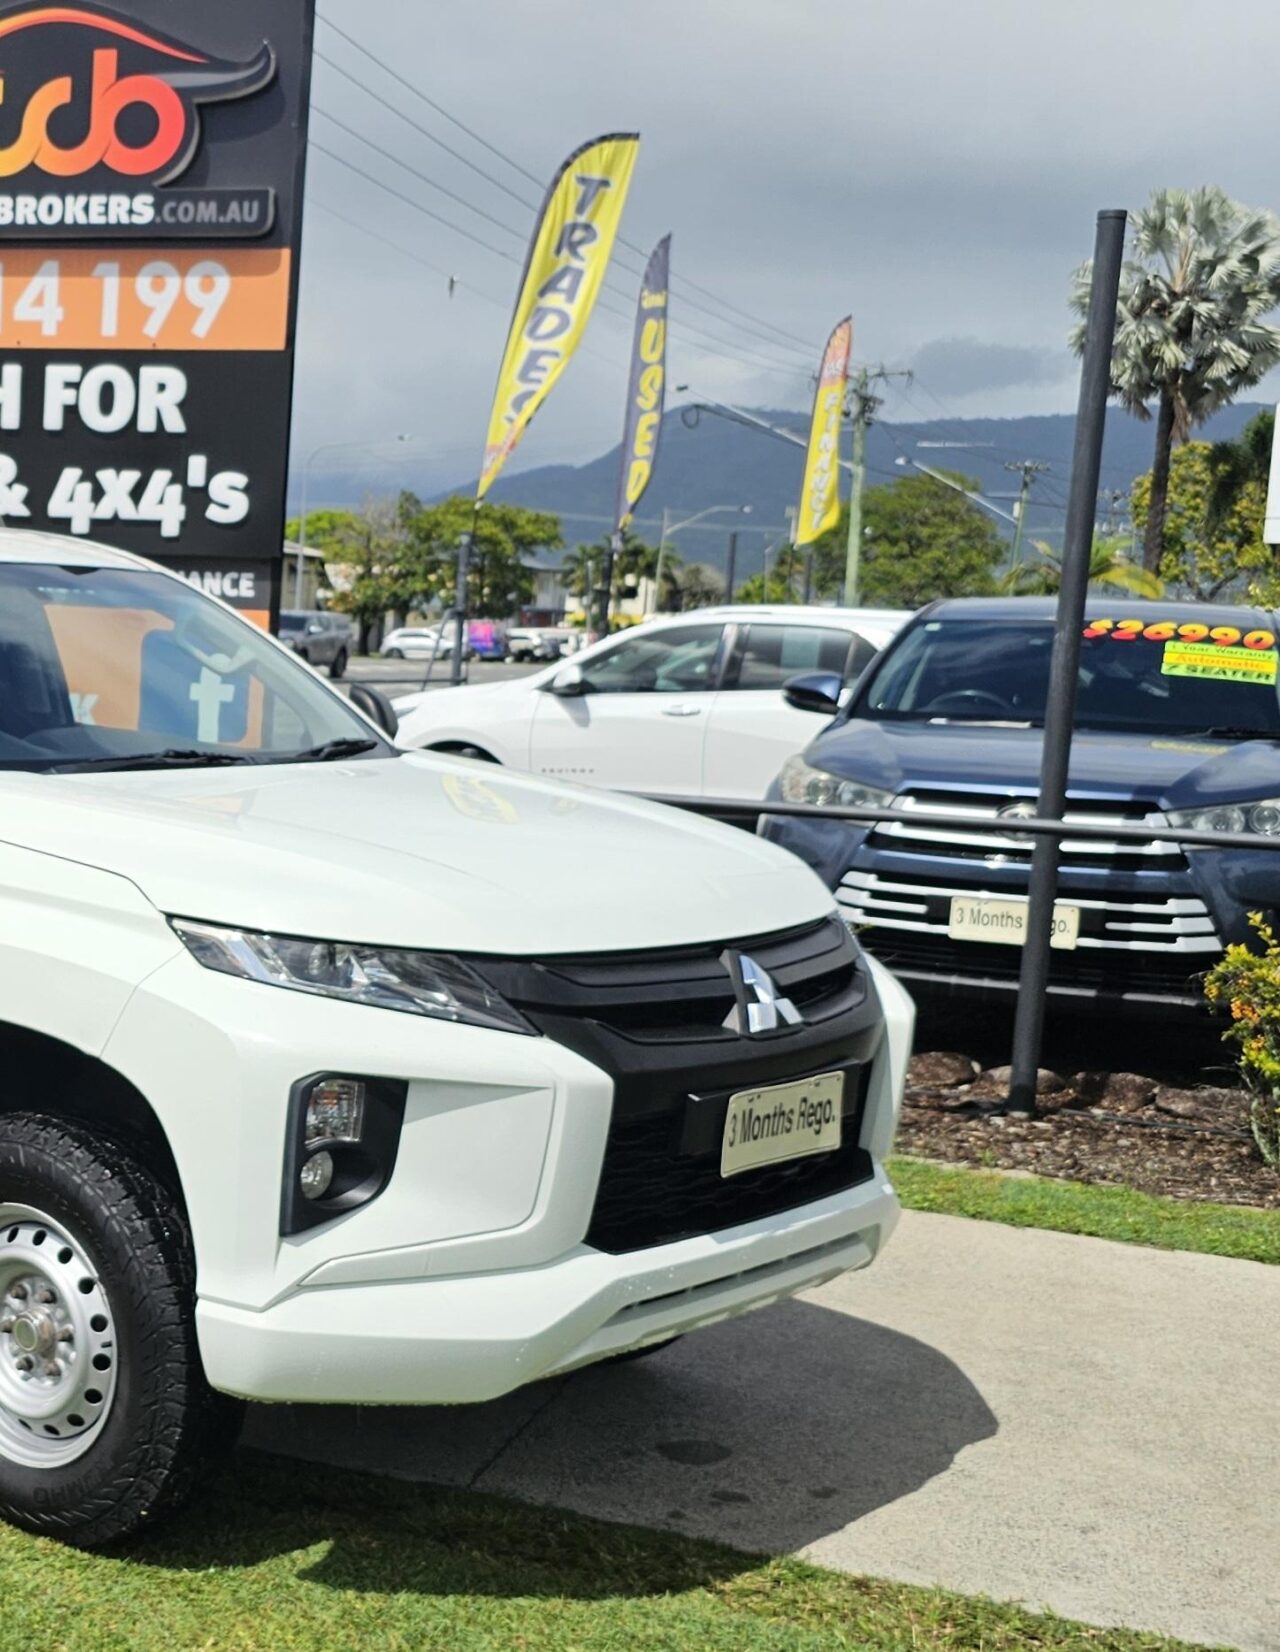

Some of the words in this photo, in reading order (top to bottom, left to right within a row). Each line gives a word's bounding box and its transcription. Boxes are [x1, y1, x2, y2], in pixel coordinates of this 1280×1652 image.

[92, 259, 232, 339] 199
[42, 363, 187, 433] FOR
[625, 318, 664, 506] USED
[177, 570, 256, 598] ANCE
[1082, 619, 1276, 650] $26990
[1186, 663, 1273, 680] SEATER
[956, 907, 965, 924] 3
[968, 907, 1024, 930] Months
[728, 1113, 737, 1148] 3
[739, 1102, 793, 1145] Months
[795, 1096, 836, 1136] Rego.
